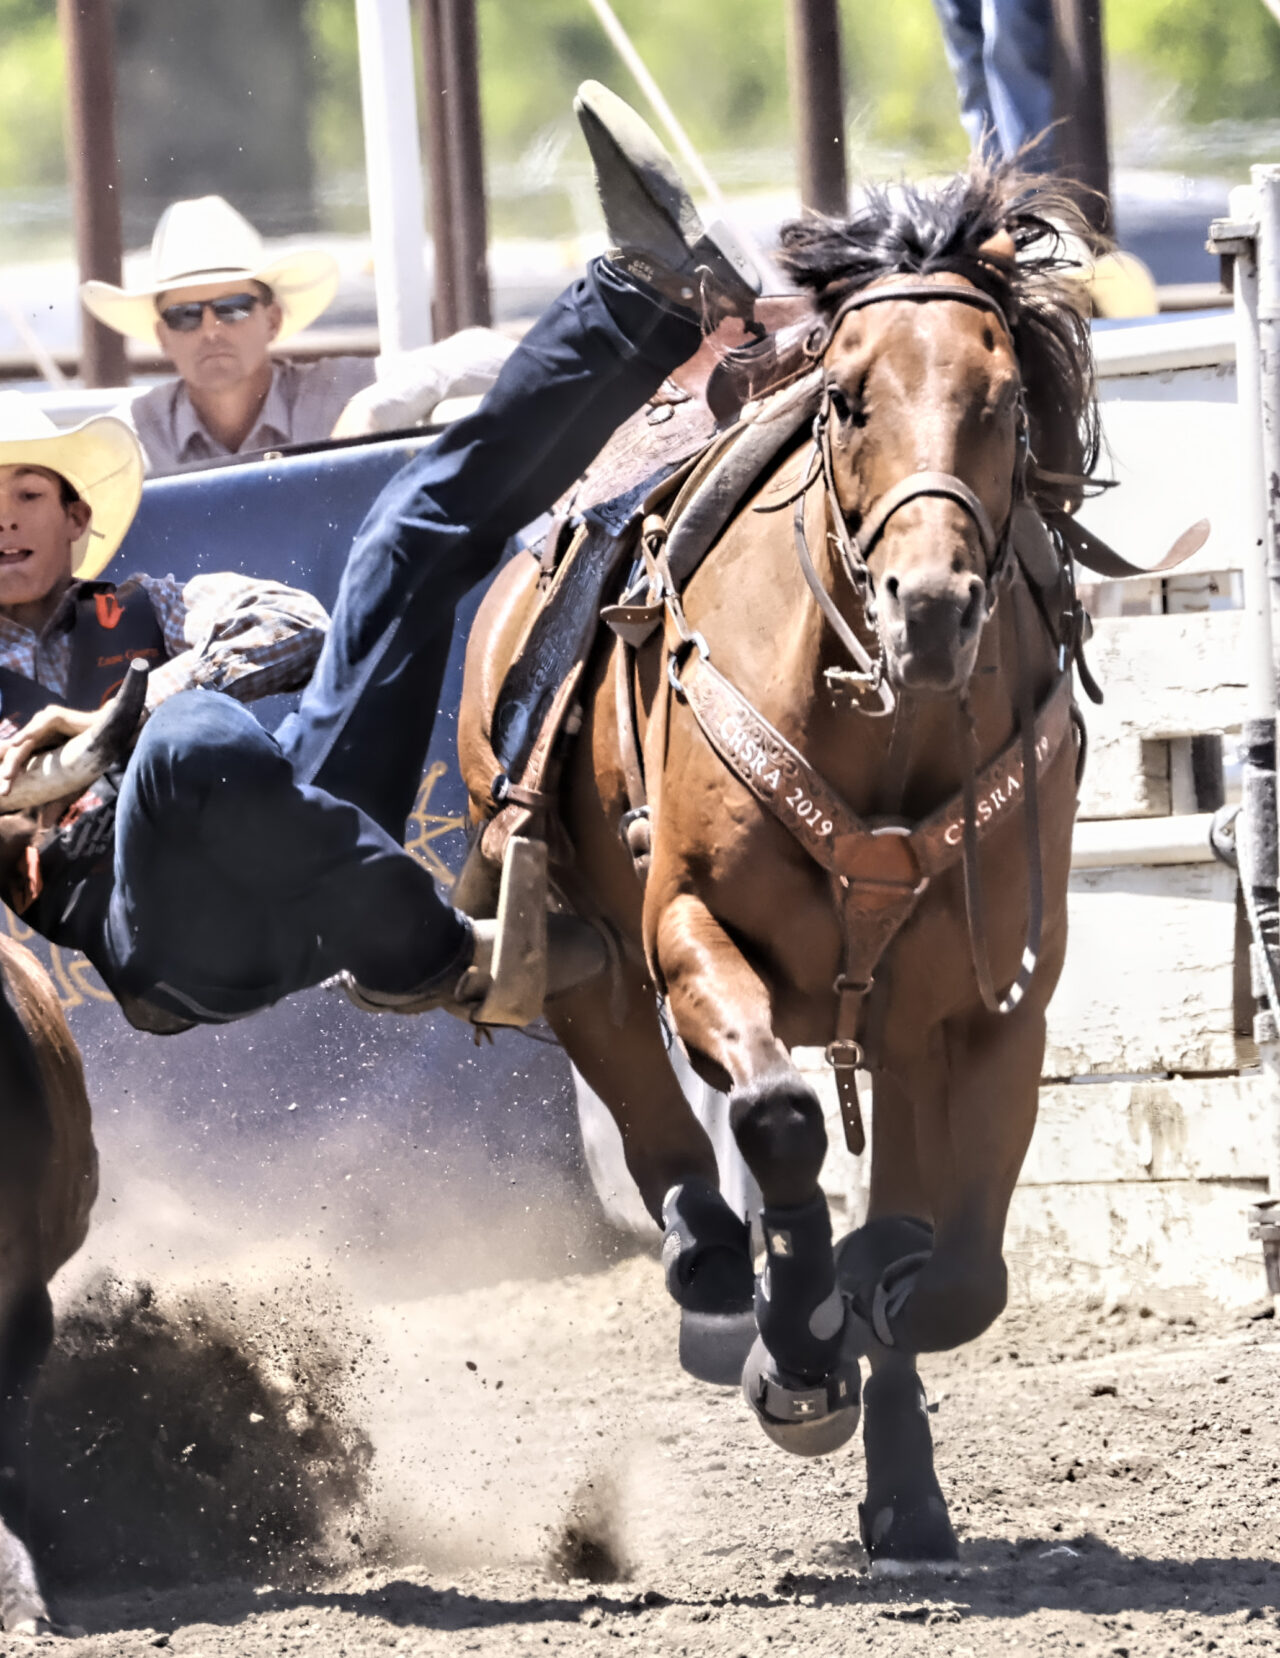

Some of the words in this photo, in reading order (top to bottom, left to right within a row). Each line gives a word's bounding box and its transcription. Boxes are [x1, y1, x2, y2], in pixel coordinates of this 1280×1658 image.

[719, 716, 781, 790] CHSRA
[784, 787, 833, 837] 2019
[943, 775, 1021, 846] CSRA
